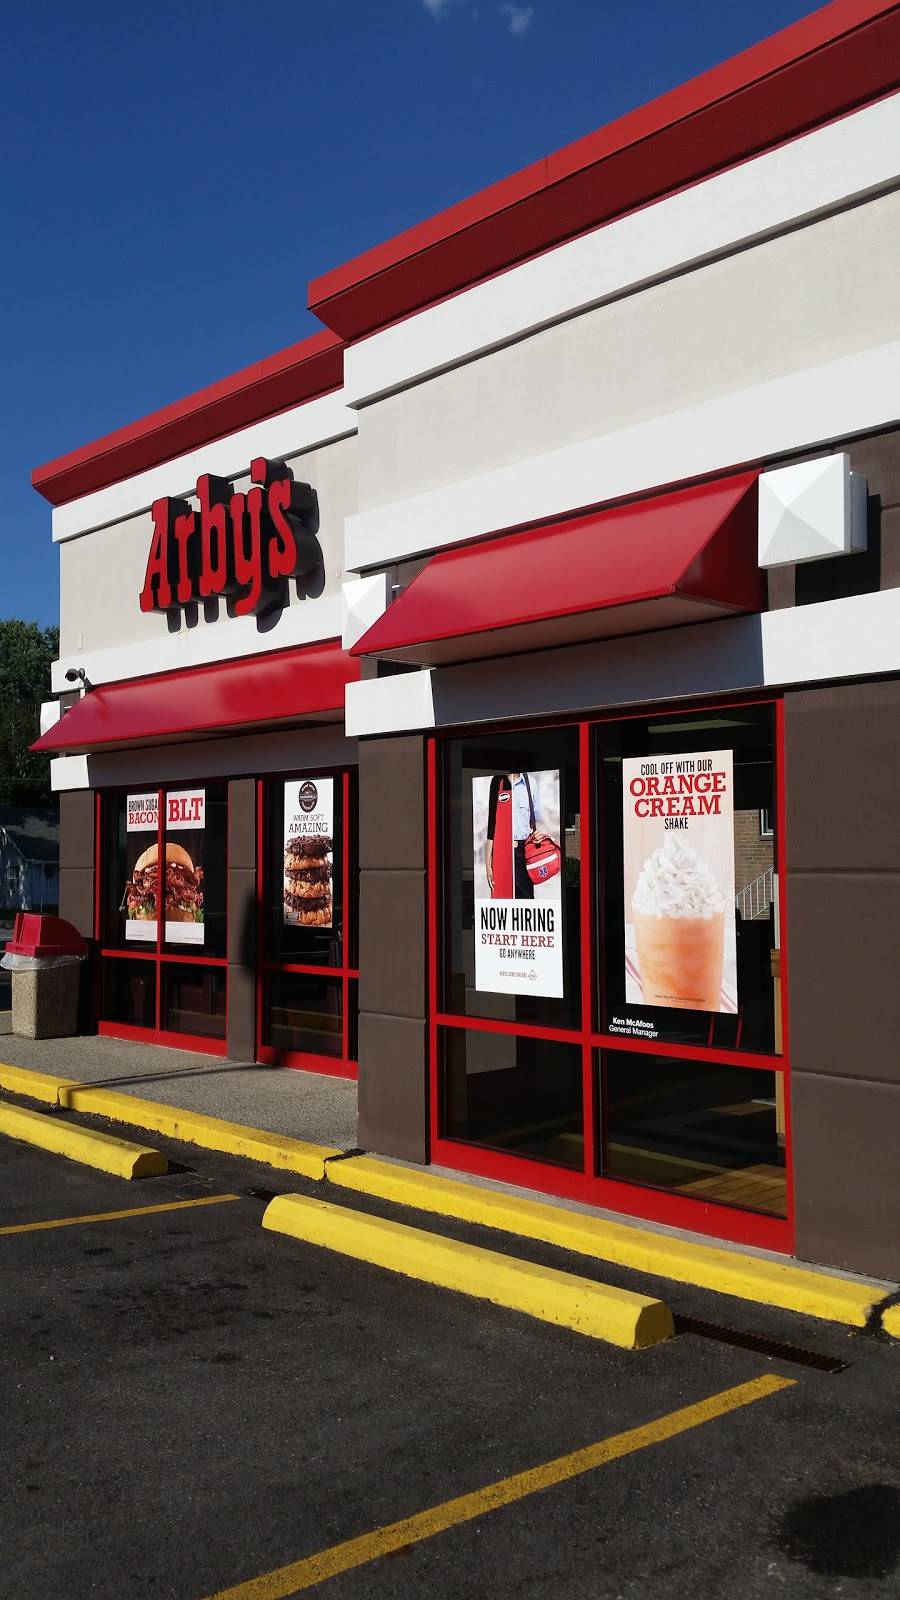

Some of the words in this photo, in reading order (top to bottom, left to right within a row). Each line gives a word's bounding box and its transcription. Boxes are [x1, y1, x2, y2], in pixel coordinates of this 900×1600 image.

[139, 456, 299, 616] Arby's
[640, 763, 658, 775] COOL
[660, 761, 674, 775] OFF
[675, 760, 695, 773] WITH
[697, 758, 713, 772] OUR
[629, 772, 726, 796] ORANGE
[128, 799, 145, 812] BROWN
[168, 797, 204, 822] BLT
[634, 795, 721, 817] CREAM
[292, 814, 309, 822] WARM
[309, 813, 325, 822] SOFT
[664, 817, 689, 830] SHAKE
[288, 821, 329, 833] AMAZING
[480, 907, 507, 930] NOW
[511, 907, 554, 932] HIRING
[481, 933, 518, 946] START
[520, 935, 555, 948] HERE
[499, 948, 506, 959] GO
[507, 949, 535, 960] ANYWHERE
[612, 1016, 625, 1026] Ken
[626, 1018, 654, 1028] McAfoos
[608, 1024, 632, 1034] General
[632, 1027, 658, 1038] Manager
